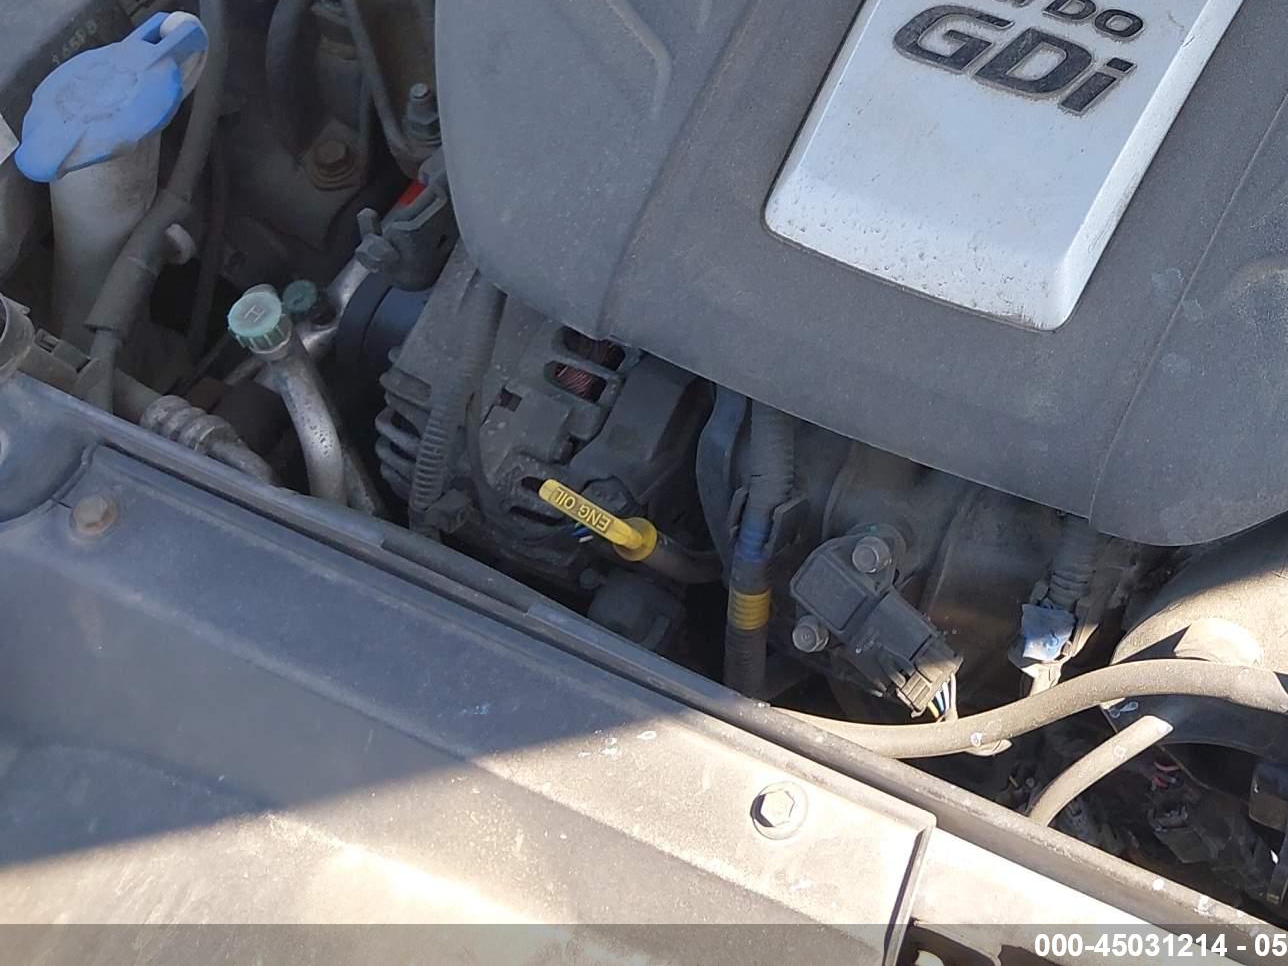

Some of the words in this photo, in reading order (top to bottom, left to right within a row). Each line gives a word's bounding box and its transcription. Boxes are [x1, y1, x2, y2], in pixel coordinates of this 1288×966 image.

[893, 3, 1137, 116] GDi
[244, 304, 265, 323] H
[554, 486, 576, 510] OIL
[577, 504, 612, 532] ENG
